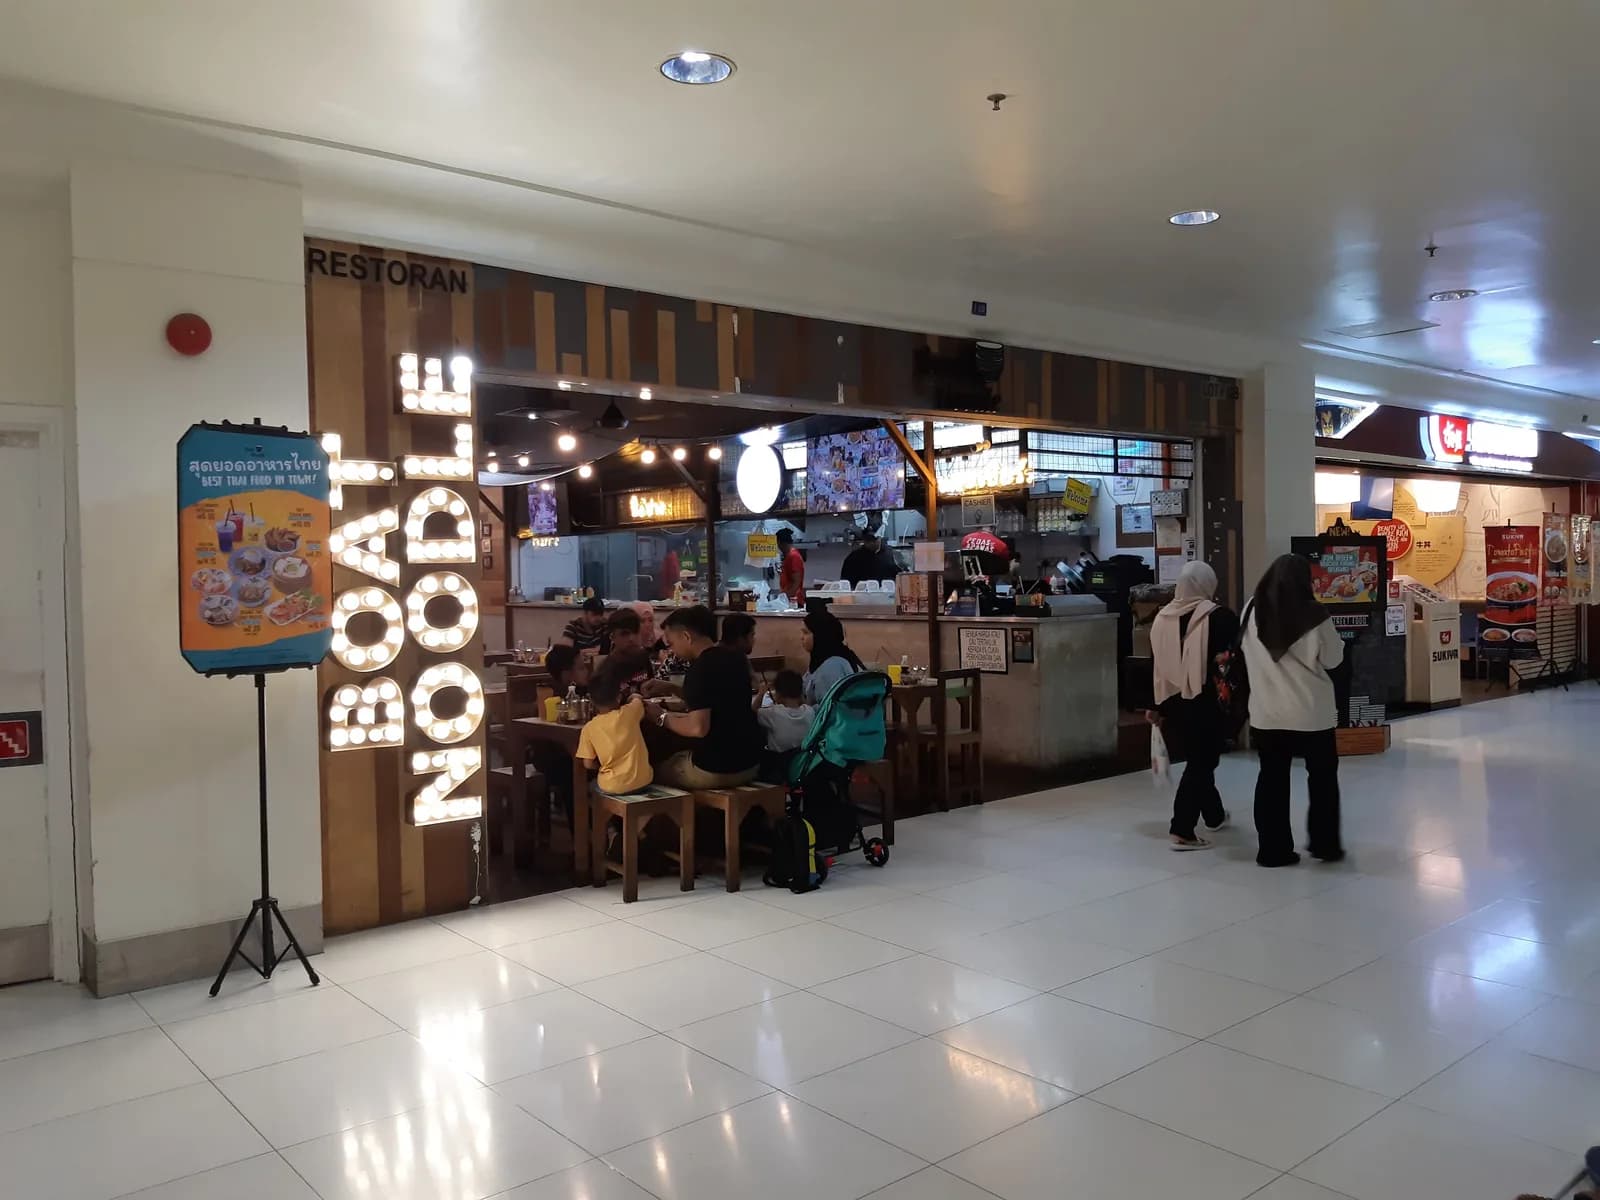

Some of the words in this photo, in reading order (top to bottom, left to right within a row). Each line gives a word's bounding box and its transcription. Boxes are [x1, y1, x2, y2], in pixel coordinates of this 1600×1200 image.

[308, 248, 467, 293] RESTORAN
[189, 452, 321, 478] สุดยอดอาหารไทย
[202, 475, 222, 487] BEST
[226, 475, 247, 486] THAI
[250, 475, 272, 486] FOOD
[288, 474, 317, 485] TOWN!
[964, 498, 991, 507] CASHIER
[1329, 526, 1350, 537] NEW!
[322, 434, 404, 752] BOAT
[399, 352, 485, 826] NOODLE
[1432, 649, 1459, 663] SUKIYA
